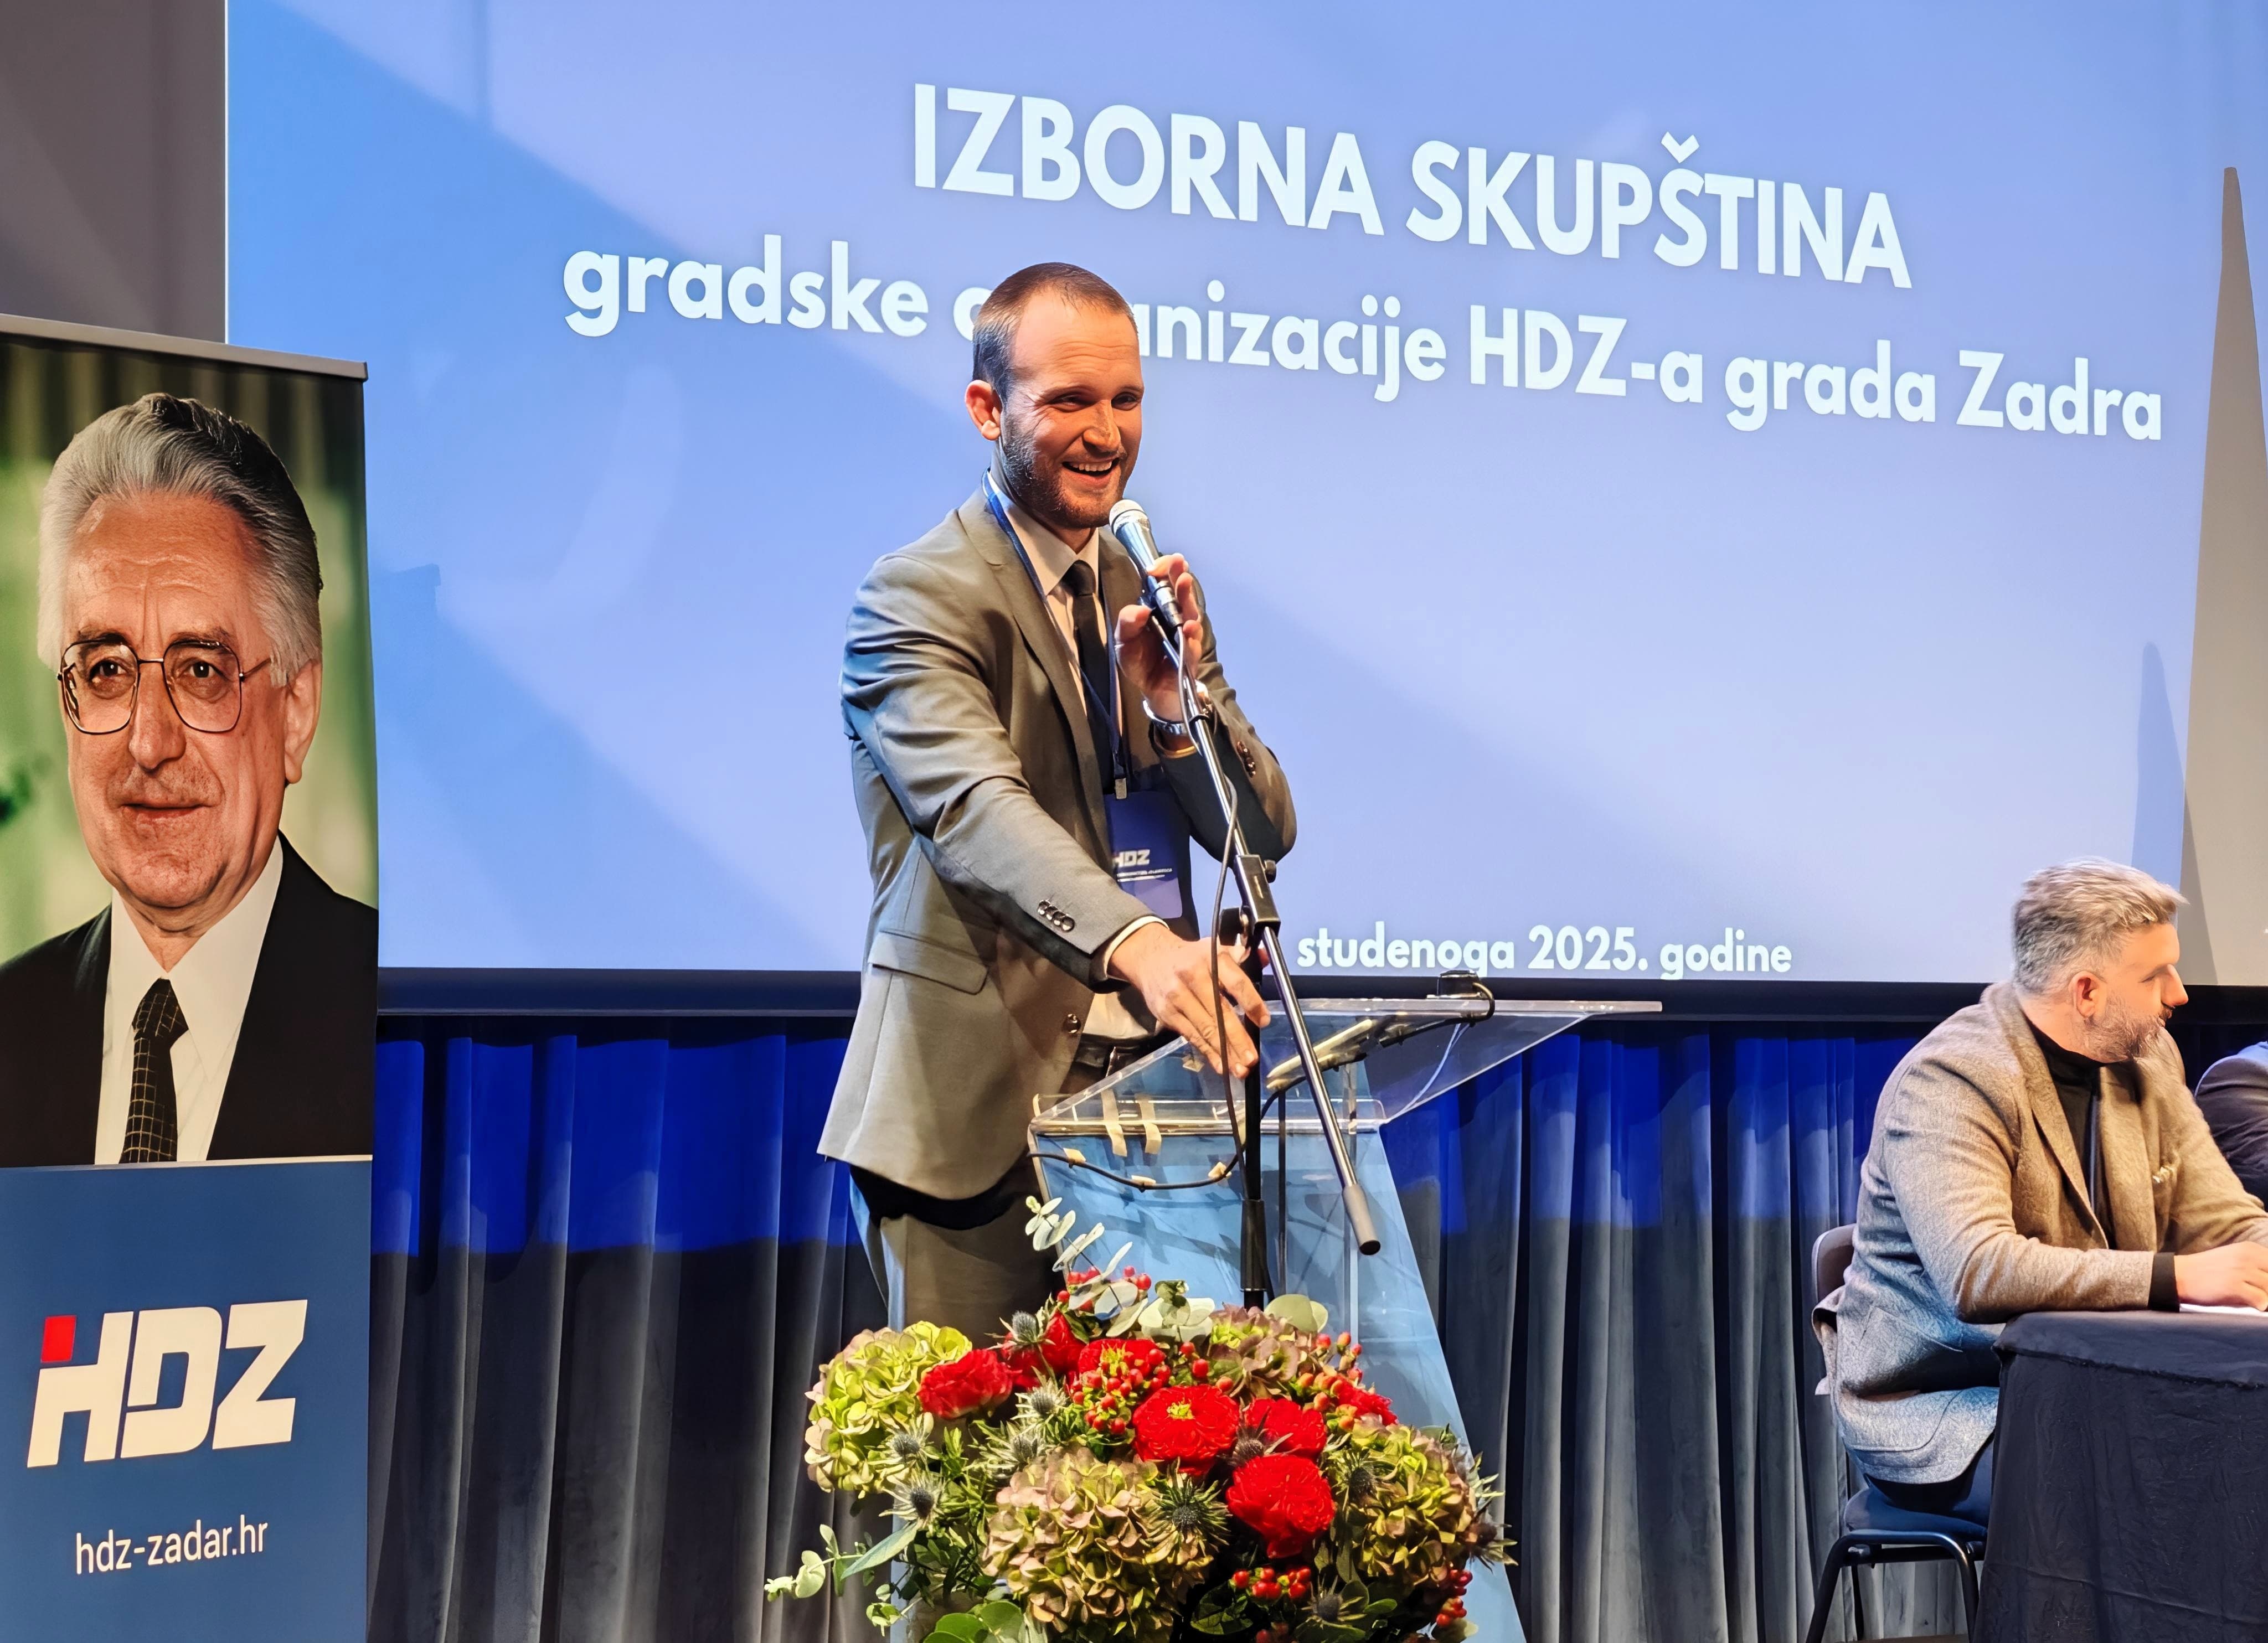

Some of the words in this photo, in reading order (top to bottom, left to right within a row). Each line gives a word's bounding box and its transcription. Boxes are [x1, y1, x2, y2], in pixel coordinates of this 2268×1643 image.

[915, 83, 1384, 236] IZBORNA
[1406, 132, 1913, 289] SKUPŠTINA
[564, 234, 929, 337] gradske
[953, 279, 1446, 402] onizacije
[1470, 304, 1703, 404] HDZ-a
[1725, 339, 1936, 432] grada
[1956, 349, 2162, 441] Zadra
[1297, 921, 1515, 978] studenoga
[1528, 924, 1649, 972] 2025.
[1659, 927, 1793, 980] godine
[27, 1299, 308, 1468] HDZ
[76, 1514, 269, 1575] hdz-zadar.hr
